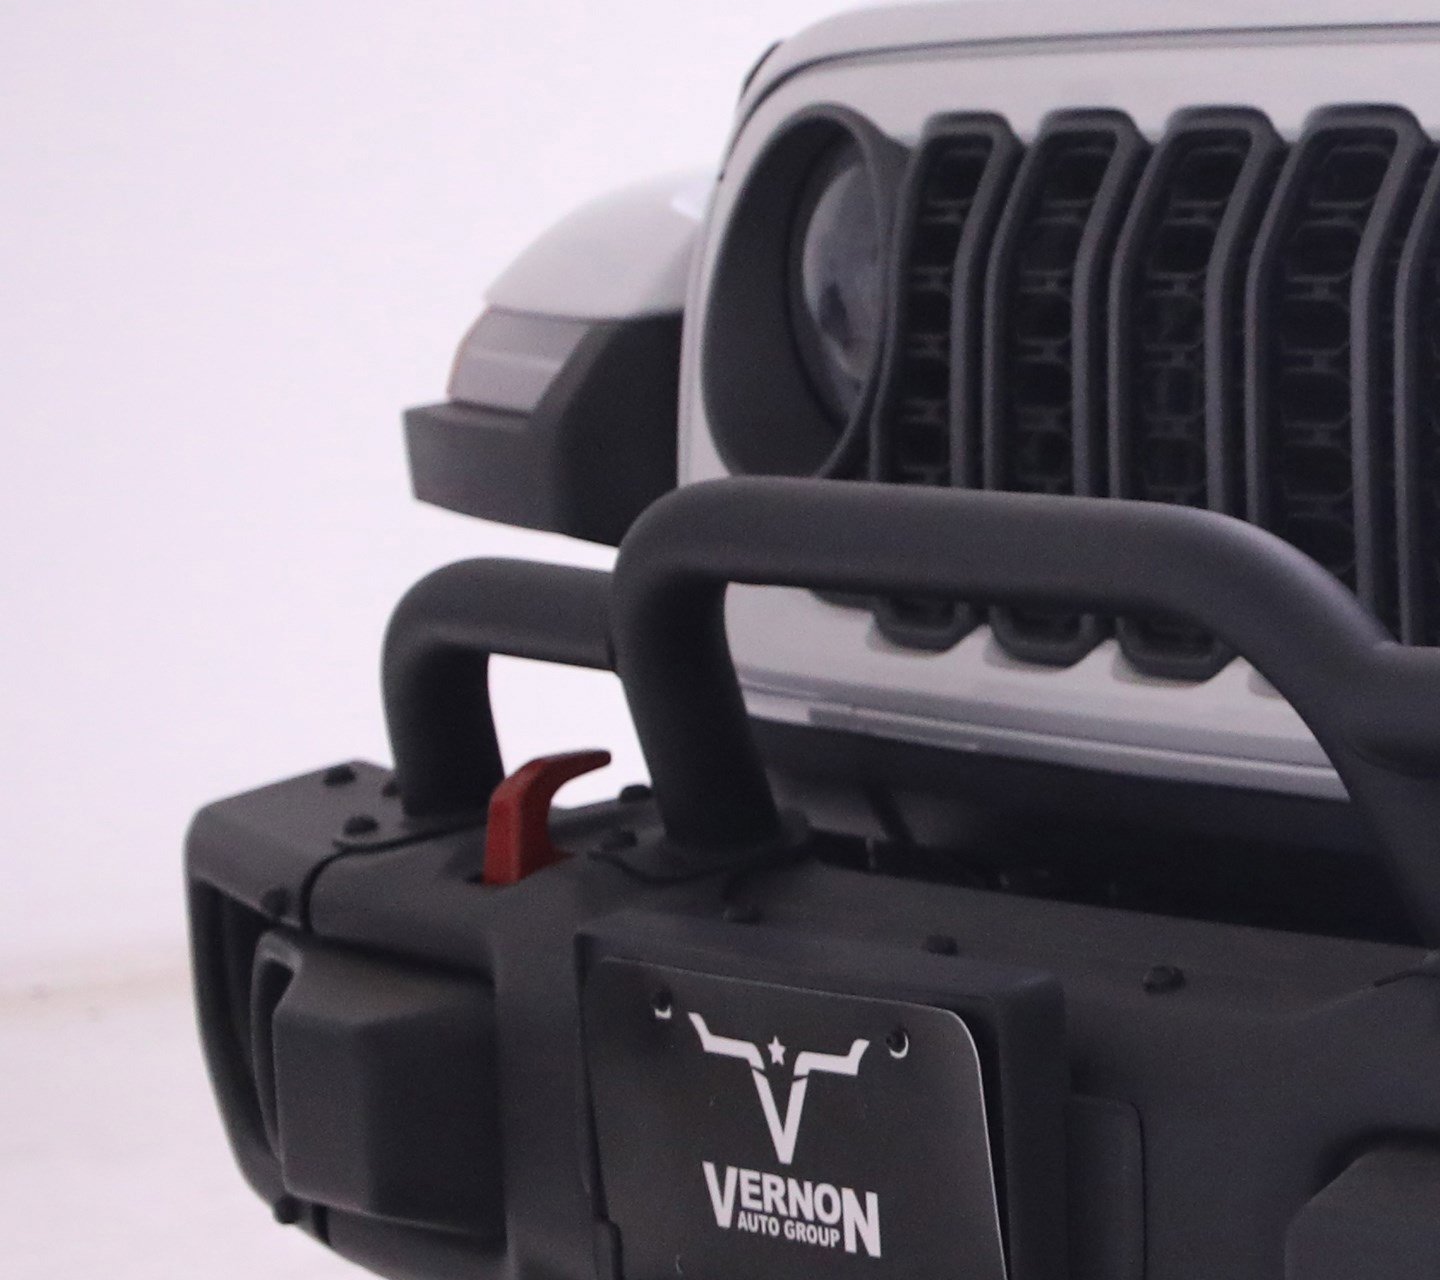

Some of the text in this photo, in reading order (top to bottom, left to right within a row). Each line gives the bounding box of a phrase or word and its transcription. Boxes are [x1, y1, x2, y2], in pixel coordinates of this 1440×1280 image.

[702, 1160, 882, 1259] VERNON
[737, 1211, 841, 1249] AUTO GROUP
